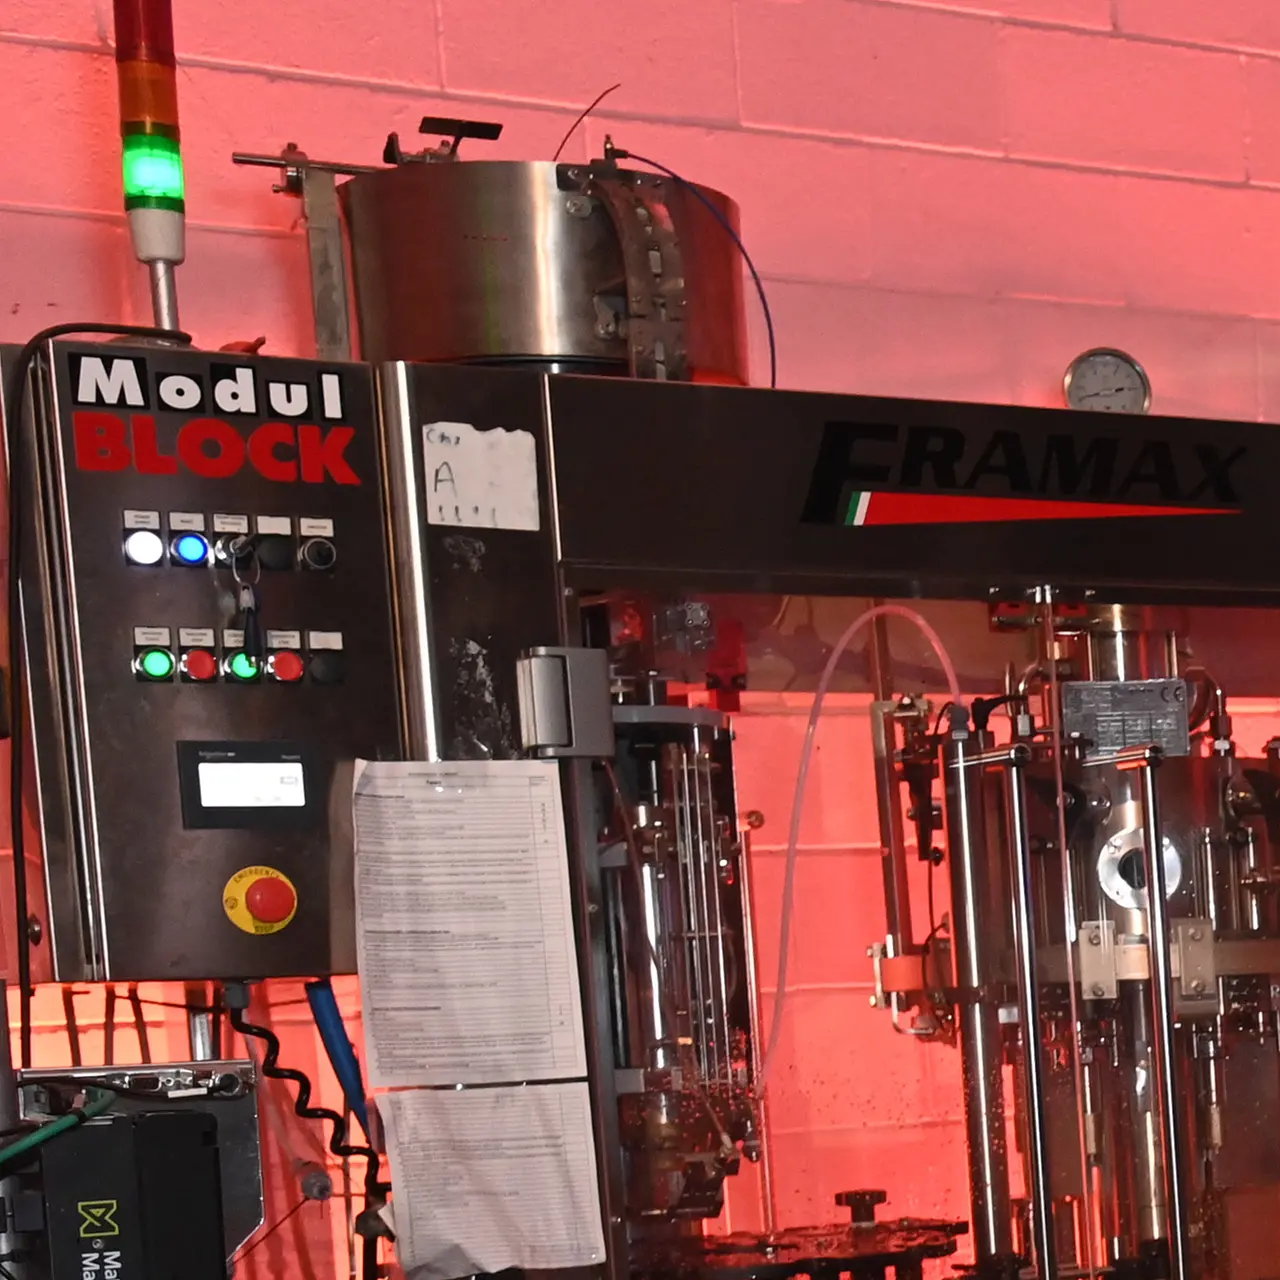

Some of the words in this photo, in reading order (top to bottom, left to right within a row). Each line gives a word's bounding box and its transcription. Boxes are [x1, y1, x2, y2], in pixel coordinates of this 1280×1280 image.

[76, 356, 343, 420] Modul
[71, 411, 362, 485] BLOCK
[800, 420, 1248, 526] FRAMAX
